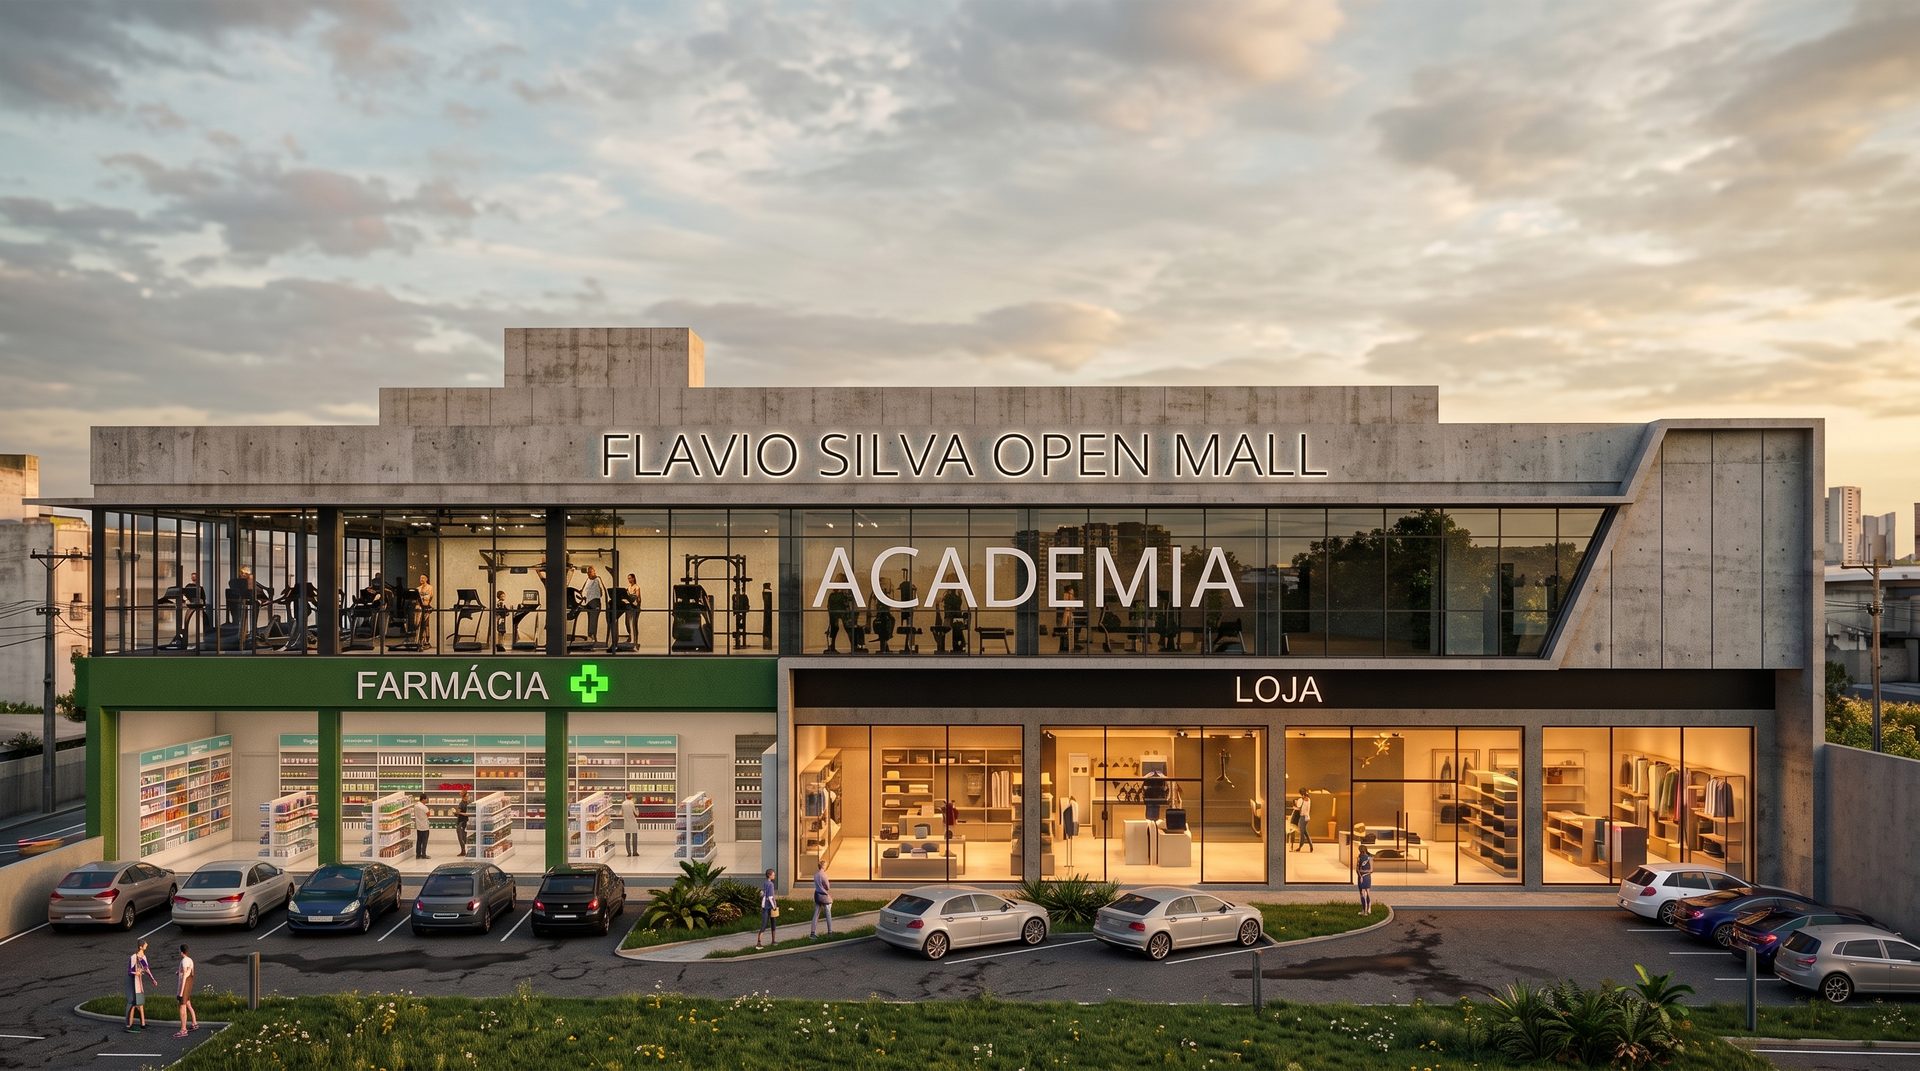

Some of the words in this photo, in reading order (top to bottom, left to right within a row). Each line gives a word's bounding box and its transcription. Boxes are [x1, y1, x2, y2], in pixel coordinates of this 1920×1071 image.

[602, 434, 797, 477] FLAVIO
[820, 434, 974, 477] SILVA
[994, 433, 1149, 477] OPEN
[1175, 434, 1328, 477] MALL
[813, 546, 1244, 609] ACADEMIA
[356, 664, 550, 701] FARMÁCIA
[1235, 675, 1324, 704] LOJA
